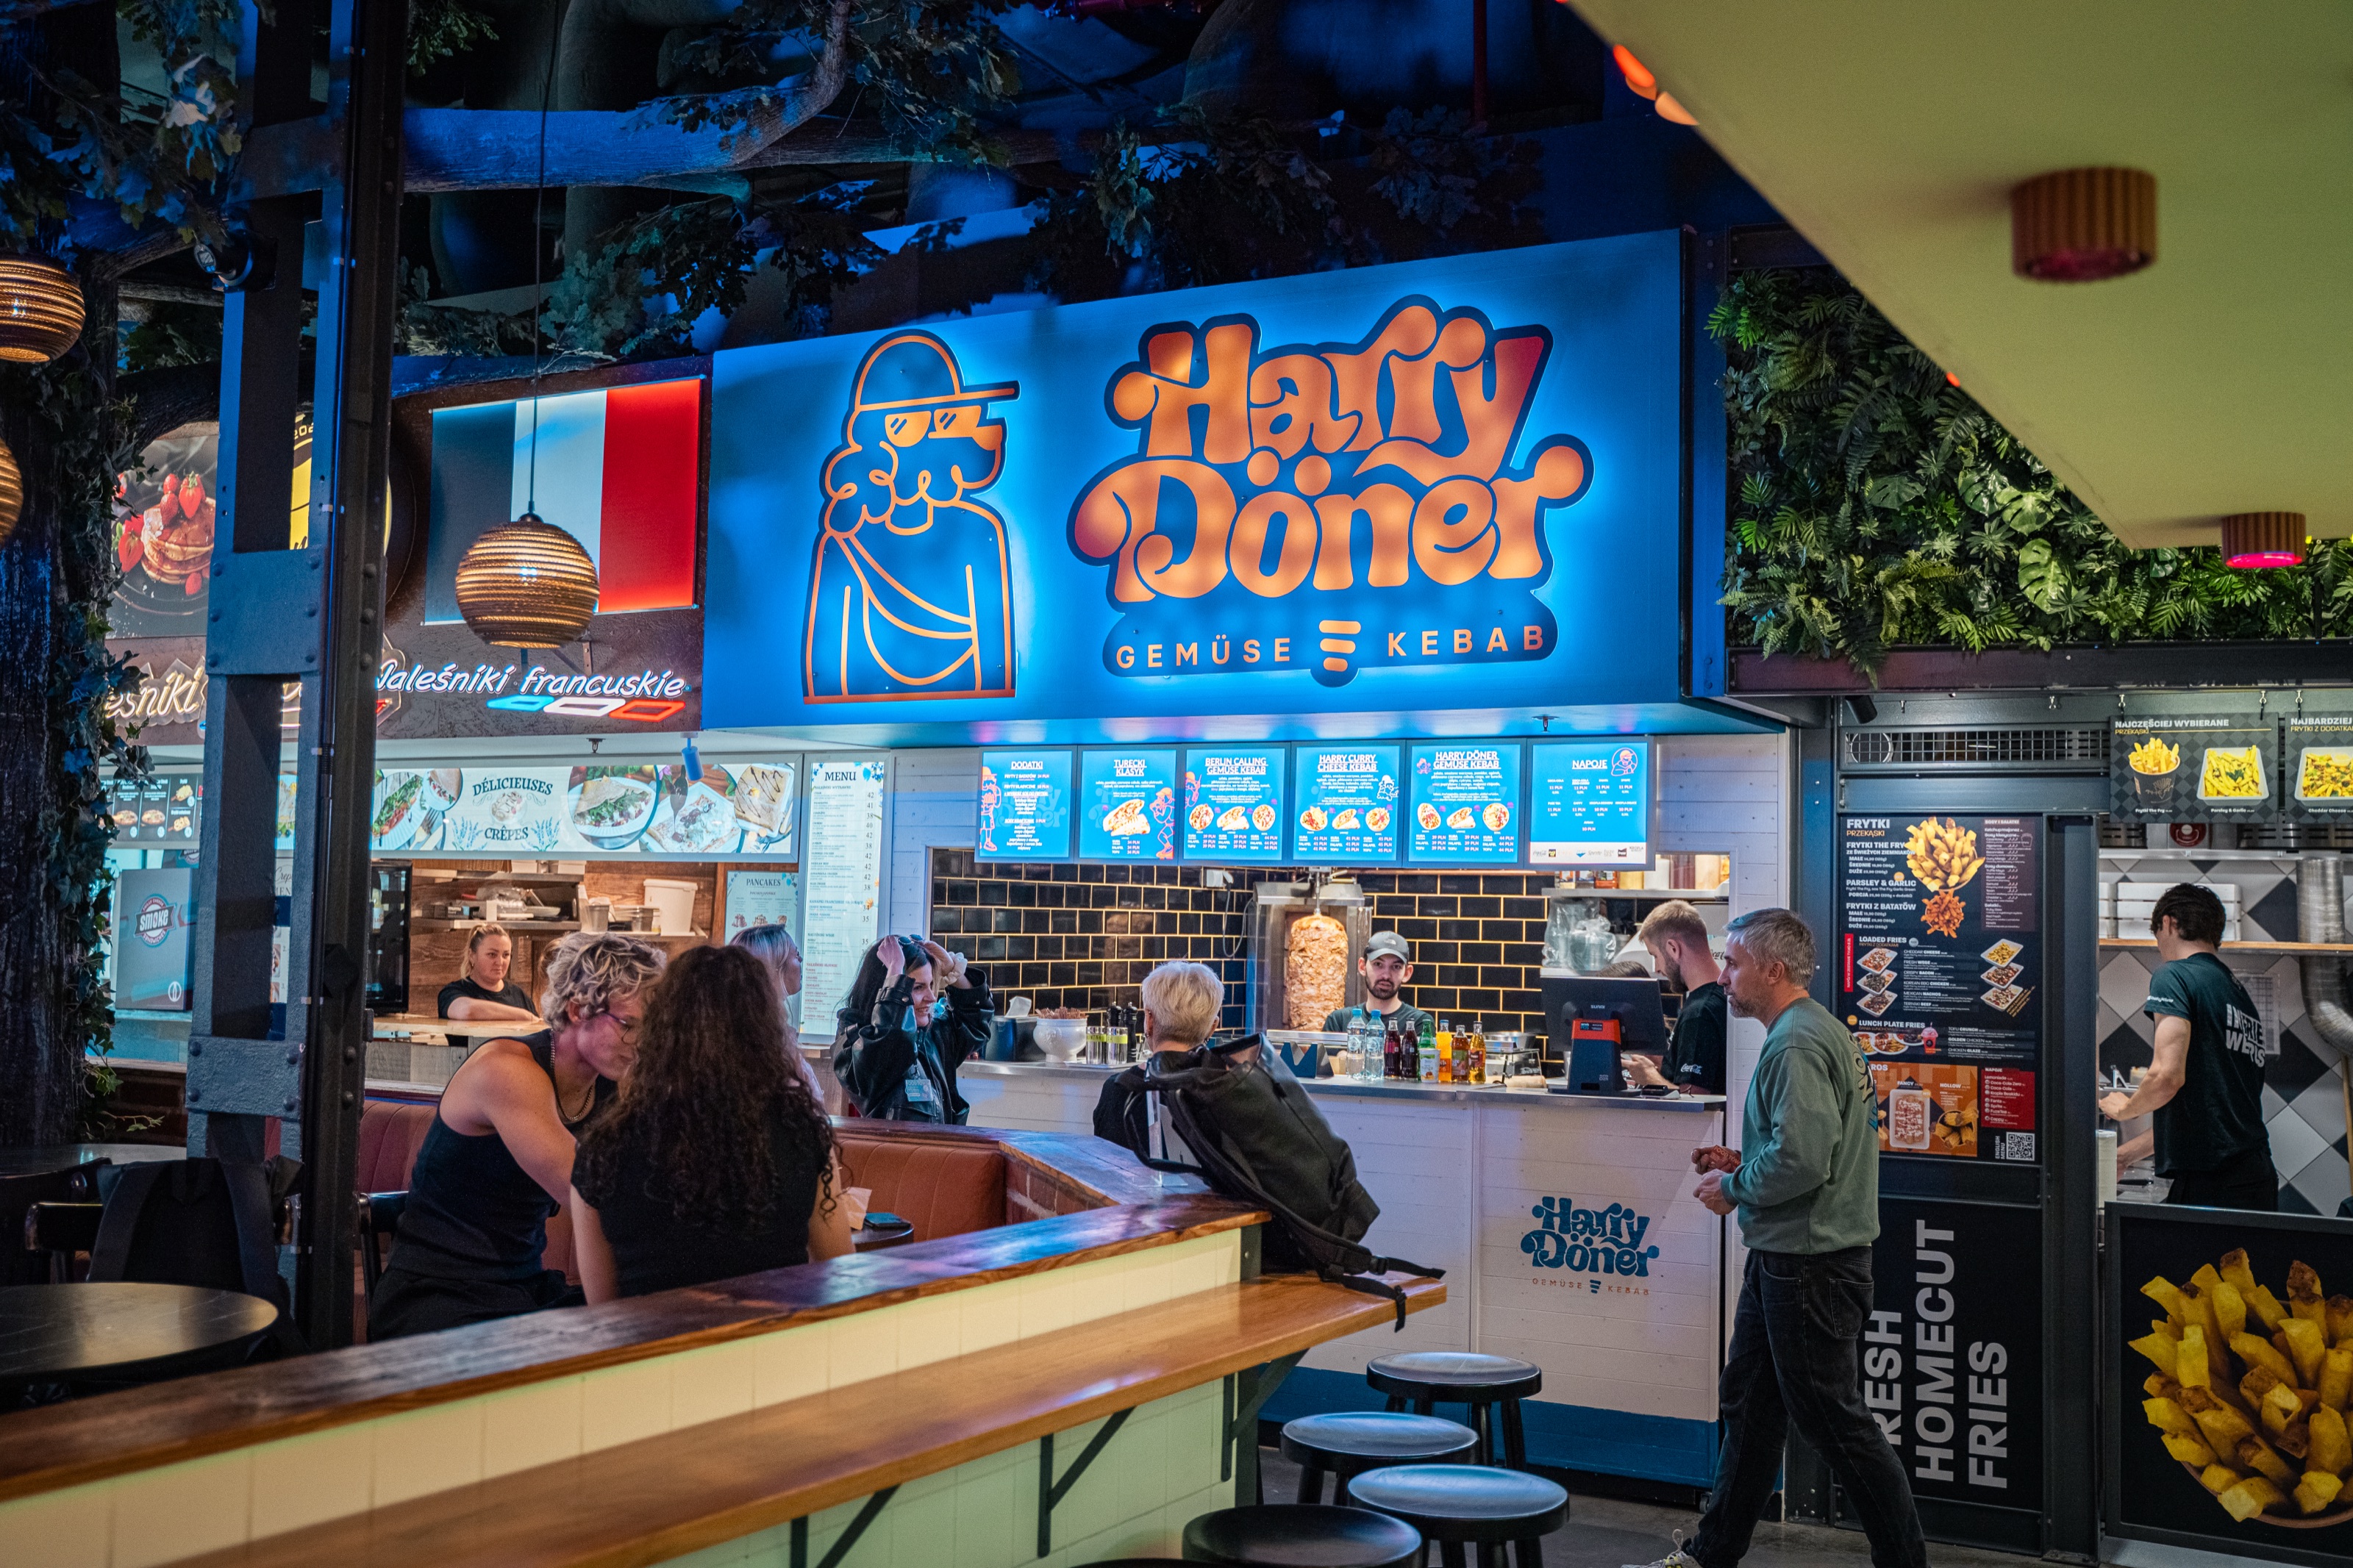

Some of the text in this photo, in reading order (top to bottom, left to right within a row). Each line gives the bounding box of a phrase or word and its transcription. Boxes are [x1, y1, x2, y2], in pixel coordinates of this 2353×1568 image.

[1113, 305, 1544, 487] Harry
[1074, 445, 1584, 603] Döner
[1116, 625, 1543, 668] GEMÜSE KEBAB
[519, 665, 685, 698] francuskie
[2115, 719, 2172, 729] NAJCZĘŚCIEJ
[2290, 717, 2352, 726] NAJBARDZIEJ
[1319, 754, 1376, 762] HARRY CURRY
[1436, 750, 1497, 759] HARRY DÖNER
[1011, 761, 1043, 769] DODATKI
[1234, 757, 1266, 765] CALLING
[1471, 760, 1499, 768] KEBAB
[1572, 759, 1607, 768] NAPOJE
[1116, 767, 1144, 776] KLASYK
[1240, 766, 1266, 774] KEBAB
[1318, 763, 1377, 771] CHEESE KEBAB
[824, 772, 857, 781] MENU
[472, 775, 553, 796] DÉLICIEUSES
[1846, 819, 1890, 828] FRYTKI
[485, 825, 529, 840] CRÊPES
[746, 878, 781, 887] PANCAKES
[1880, 902, 1916, 910] BATATÓW
[1532, 1196, 1650, 1250] Harry
[1521, 1230, 1660, 1277] Döner
[1532, 1278, 1649, 1295] GEMÜSE KEBAB
[1915, 1219, 1954, 1482] HOMECUT
[1864, 1310, 1902, 1445] RESH
[1968, 1342, 2007, 1489] FRIES
